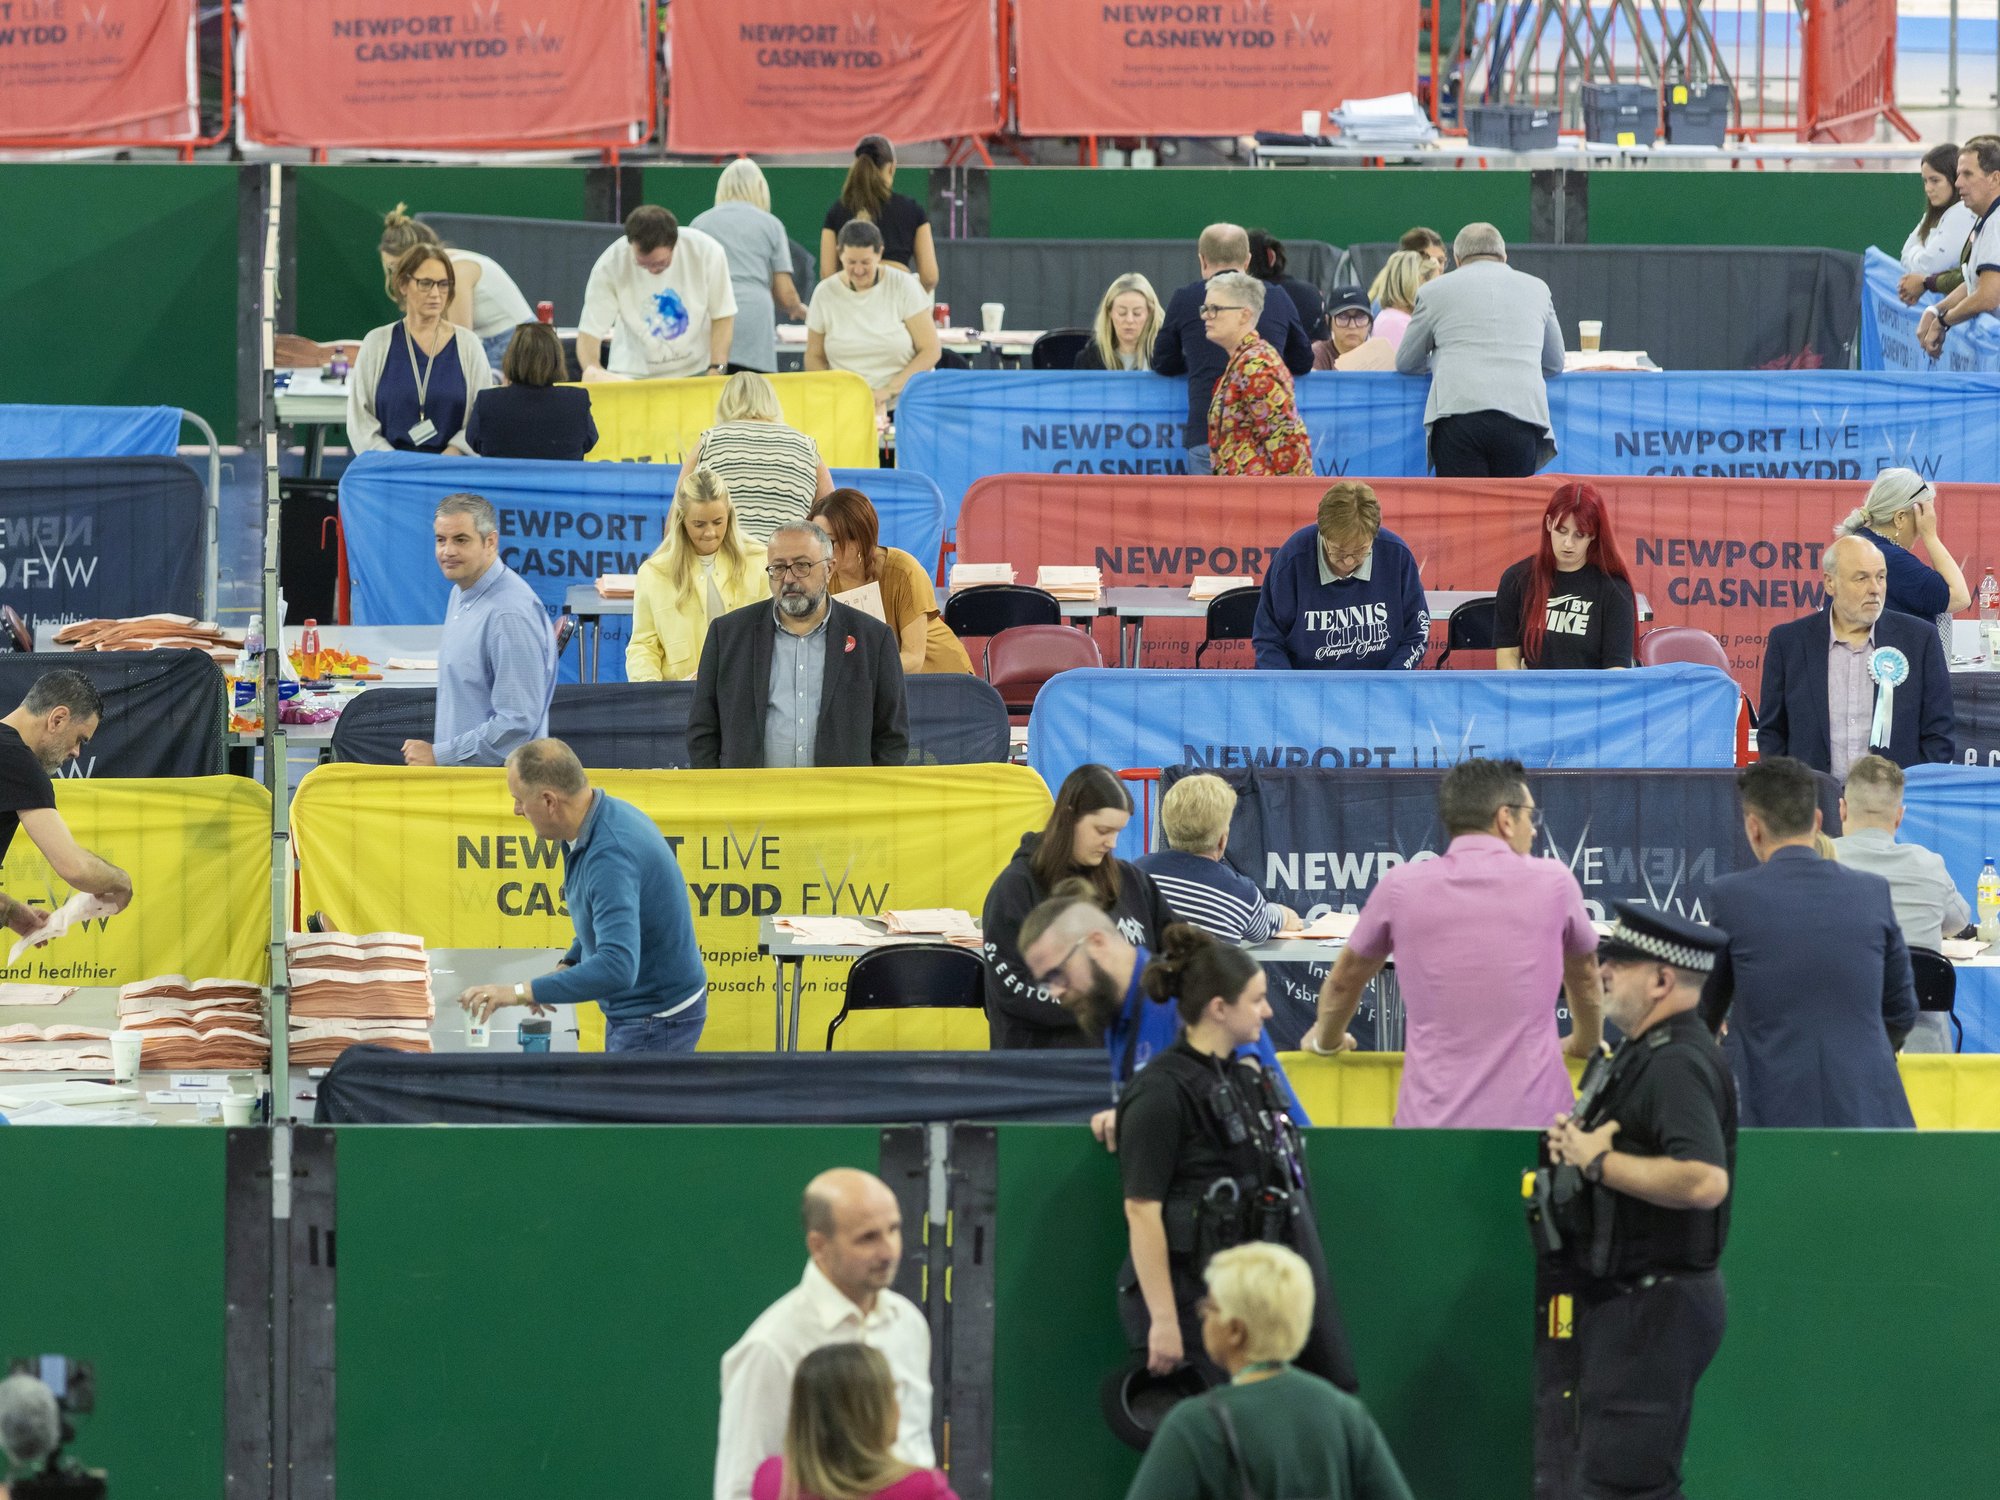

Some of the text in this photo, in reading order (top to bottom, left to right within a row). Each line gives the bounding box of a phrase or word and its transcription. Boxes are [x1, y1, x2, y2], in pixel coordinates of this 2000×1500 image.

[1103, 5, 1224, 23] NEWPORT
[333, 15, 454, 37] NEWPORT
[740, 24, 838, 43] NEWPORT
[355, 38, 507, 61] CASNEWYDD
[1123, 29, 1275, 48] CASNEWYDD
[757, 48, 882, 68] CASNEWYDD
[1614, 410, 1859, 457] NEWPORT LIVE
[1053, 459, 1188, 475] CASNEW
[500, 509, 647, 541] EWPORT
[23, 540, 98, 589] FYW
[502, 547, 652, 577] CASNEW
[1636, 538, 1824, 570] NEWPORT
[1668, 576, 1826, 608] CASNEW
[1304, 602, 1388, 631] TENNIS
[1570, 600, 1593, 614] BY
[1127, 637, 1190, 653] Ispiring
[1326, 621, 1391, 648] CLUB
[1735, 634, 1769, 648] peop
[1356, 641, 1387, 660] Sports
[1729, 655, 1759, 669] obol
[457, 824, 780, 870] NEWT LIVE
[1266, 851, 1441, 890] NEWP
[497, 860, 890, 916] CAYDD FYW
[0, 961, 117, 979] and healthier
[707, 975, 765, 994] pusach
